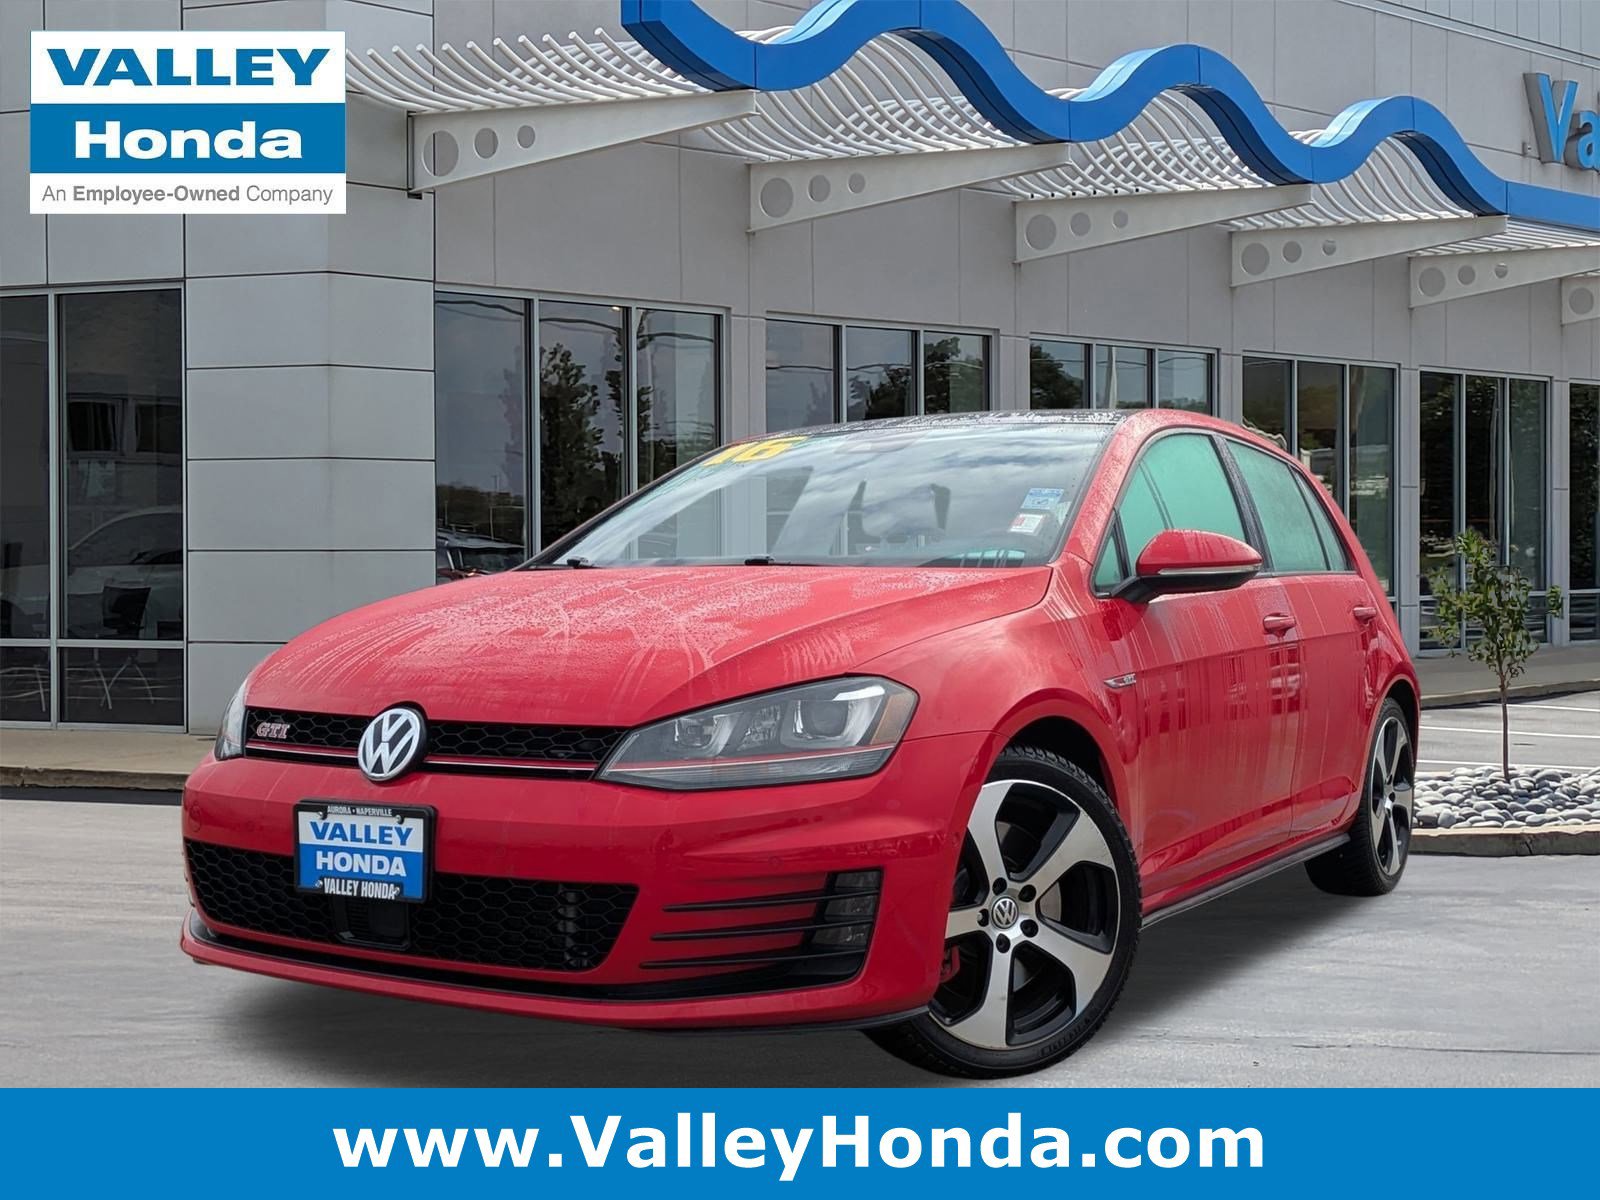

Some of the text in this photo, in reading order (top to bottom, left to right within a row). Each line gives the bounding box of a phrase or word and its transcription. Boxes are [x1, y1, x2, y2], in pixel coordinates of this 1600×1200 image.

[256, 722, 290, 739] GTI
[327, 805, 393, 817] AURORA NAPERVILLE
[309, 821, 413, 846] VALLEY
[316, 850, 407, 877] HONDA
[323, 877, 396, 900] VALLEY HONDA
